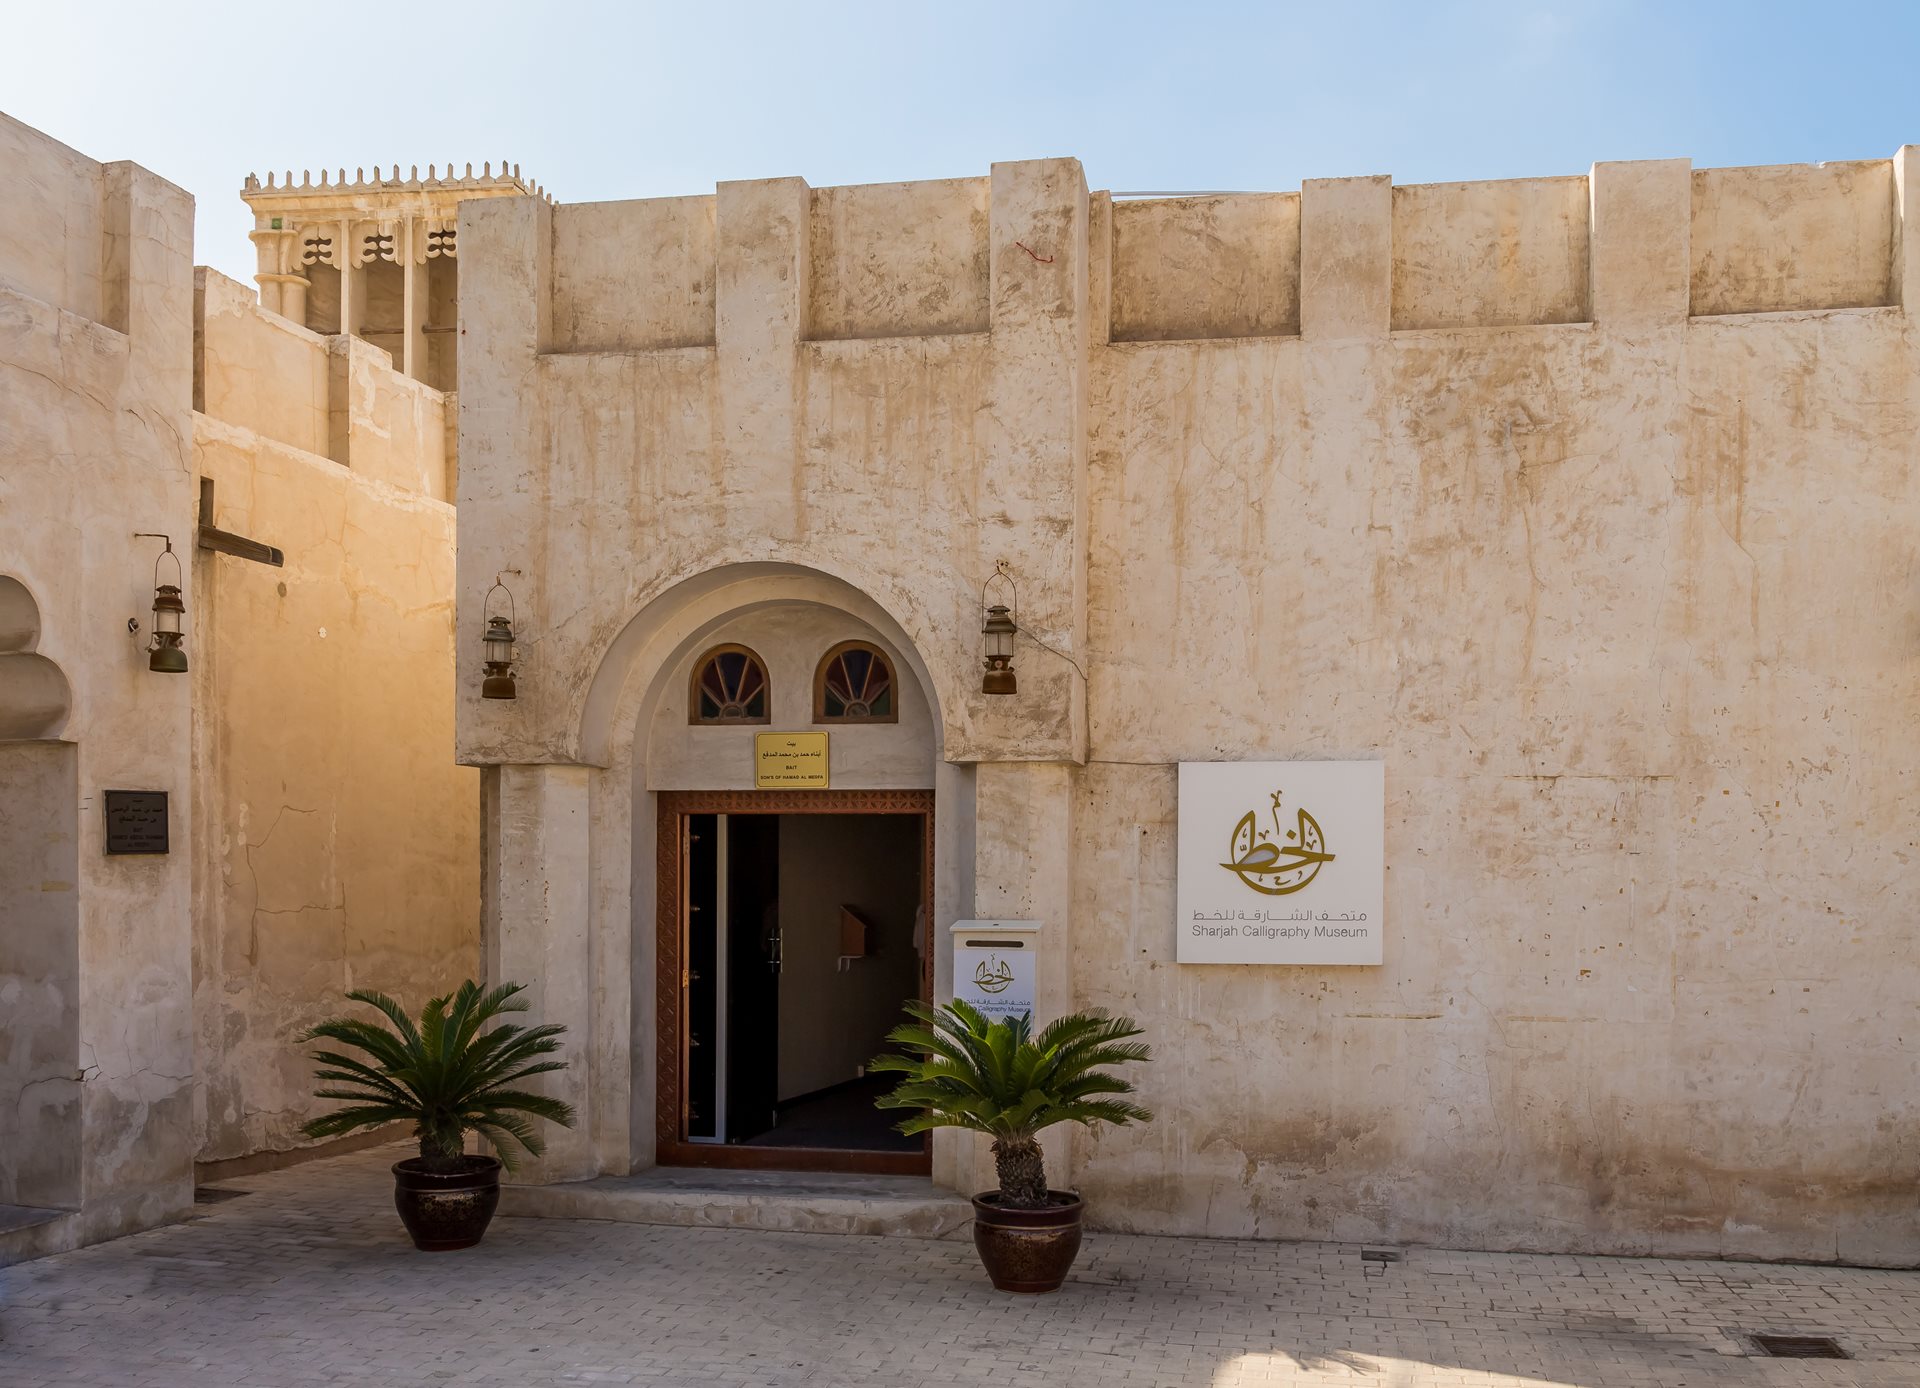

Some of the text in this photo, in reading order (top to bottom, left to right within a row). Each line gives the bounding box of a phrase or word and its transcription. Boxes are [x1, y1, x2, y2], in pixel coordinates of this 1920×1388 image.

[1192, 908, 1367, 923] متحف الشارقة للخط
[1191, 925, 1368, 940] Sharjah Calligraphy Museum
